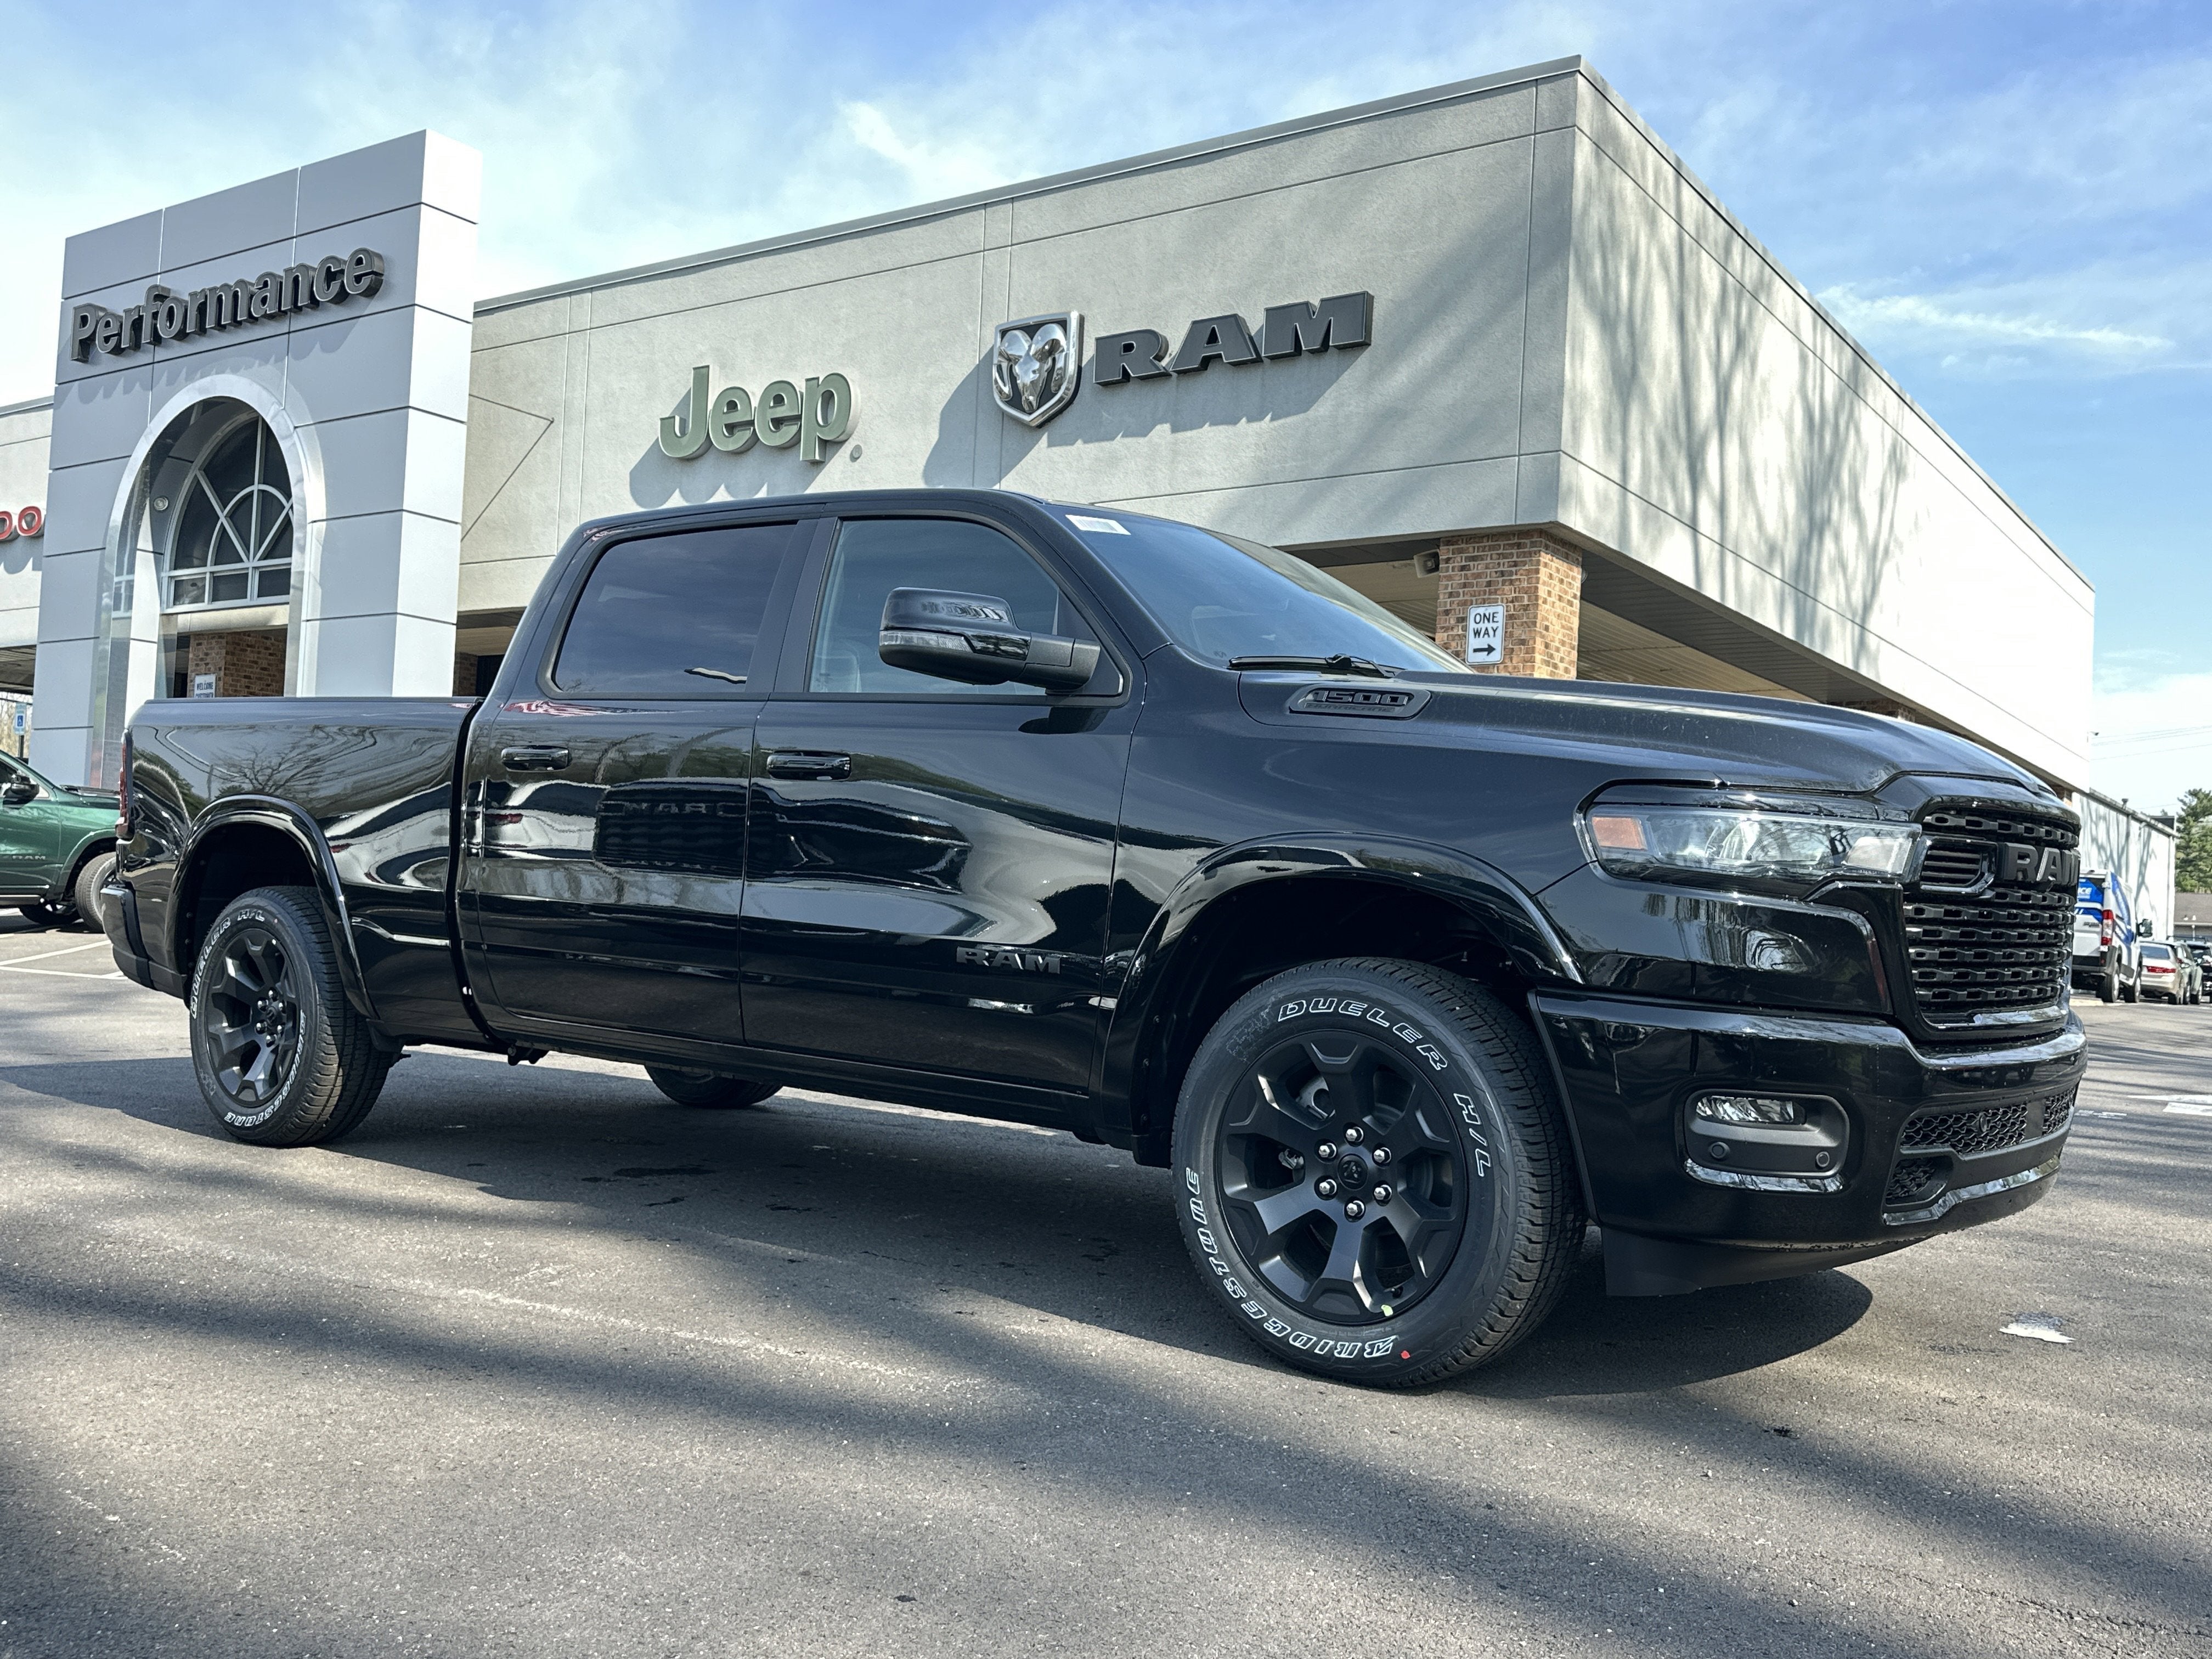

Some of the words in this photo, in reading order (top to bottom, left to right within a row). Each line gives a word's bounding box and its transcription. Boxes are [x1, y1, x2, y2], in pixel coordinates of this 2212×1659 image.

[70, 247, 383, 363] Performance
[1093, 291, 1374, 385] RAM
[659, 365, 858, 463] Jeep
[1472, 626, 1499, 639] WAY
[1474, 612, 1499, 624] ONE
[1313, 690, 1409, 706] 1500
[2003, 842, 2081, 886] RAM
[956, 946, 1061, 974] RAM
[1278, 997, 1448, 1070] DUELER
[1453, 1093, 1491, 1177] H/L
[1186, 1167, 1399, 1358] BRIDGESTONE
